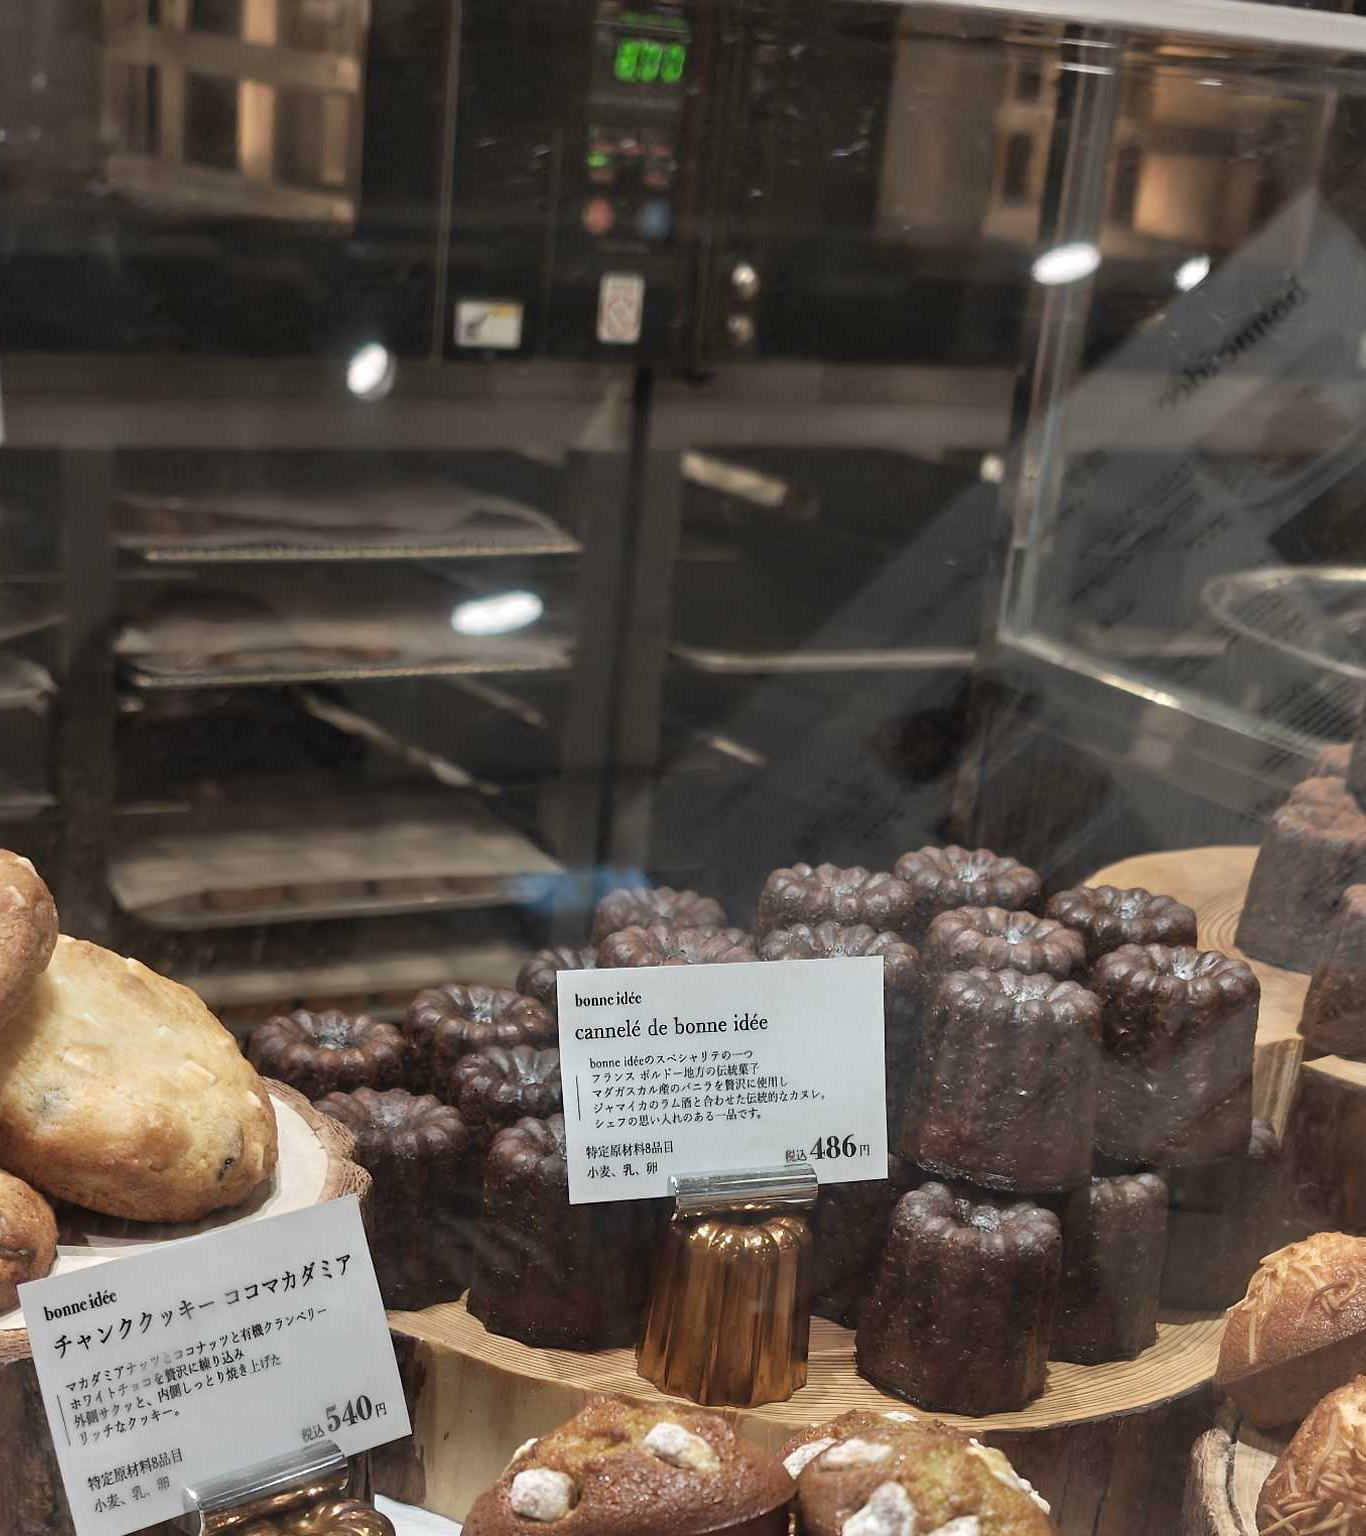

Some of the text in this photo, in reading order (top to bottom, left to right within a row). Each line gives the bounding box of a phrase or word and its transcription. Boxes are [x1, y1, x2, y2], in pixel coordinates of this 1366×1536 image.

[573, 1011, 768, 1041] cannelé de bonne idée
[588, 1056, 621, 1069] bonne
[52, 1253, 351, 1359] チャンククッキー ココマカダミア
